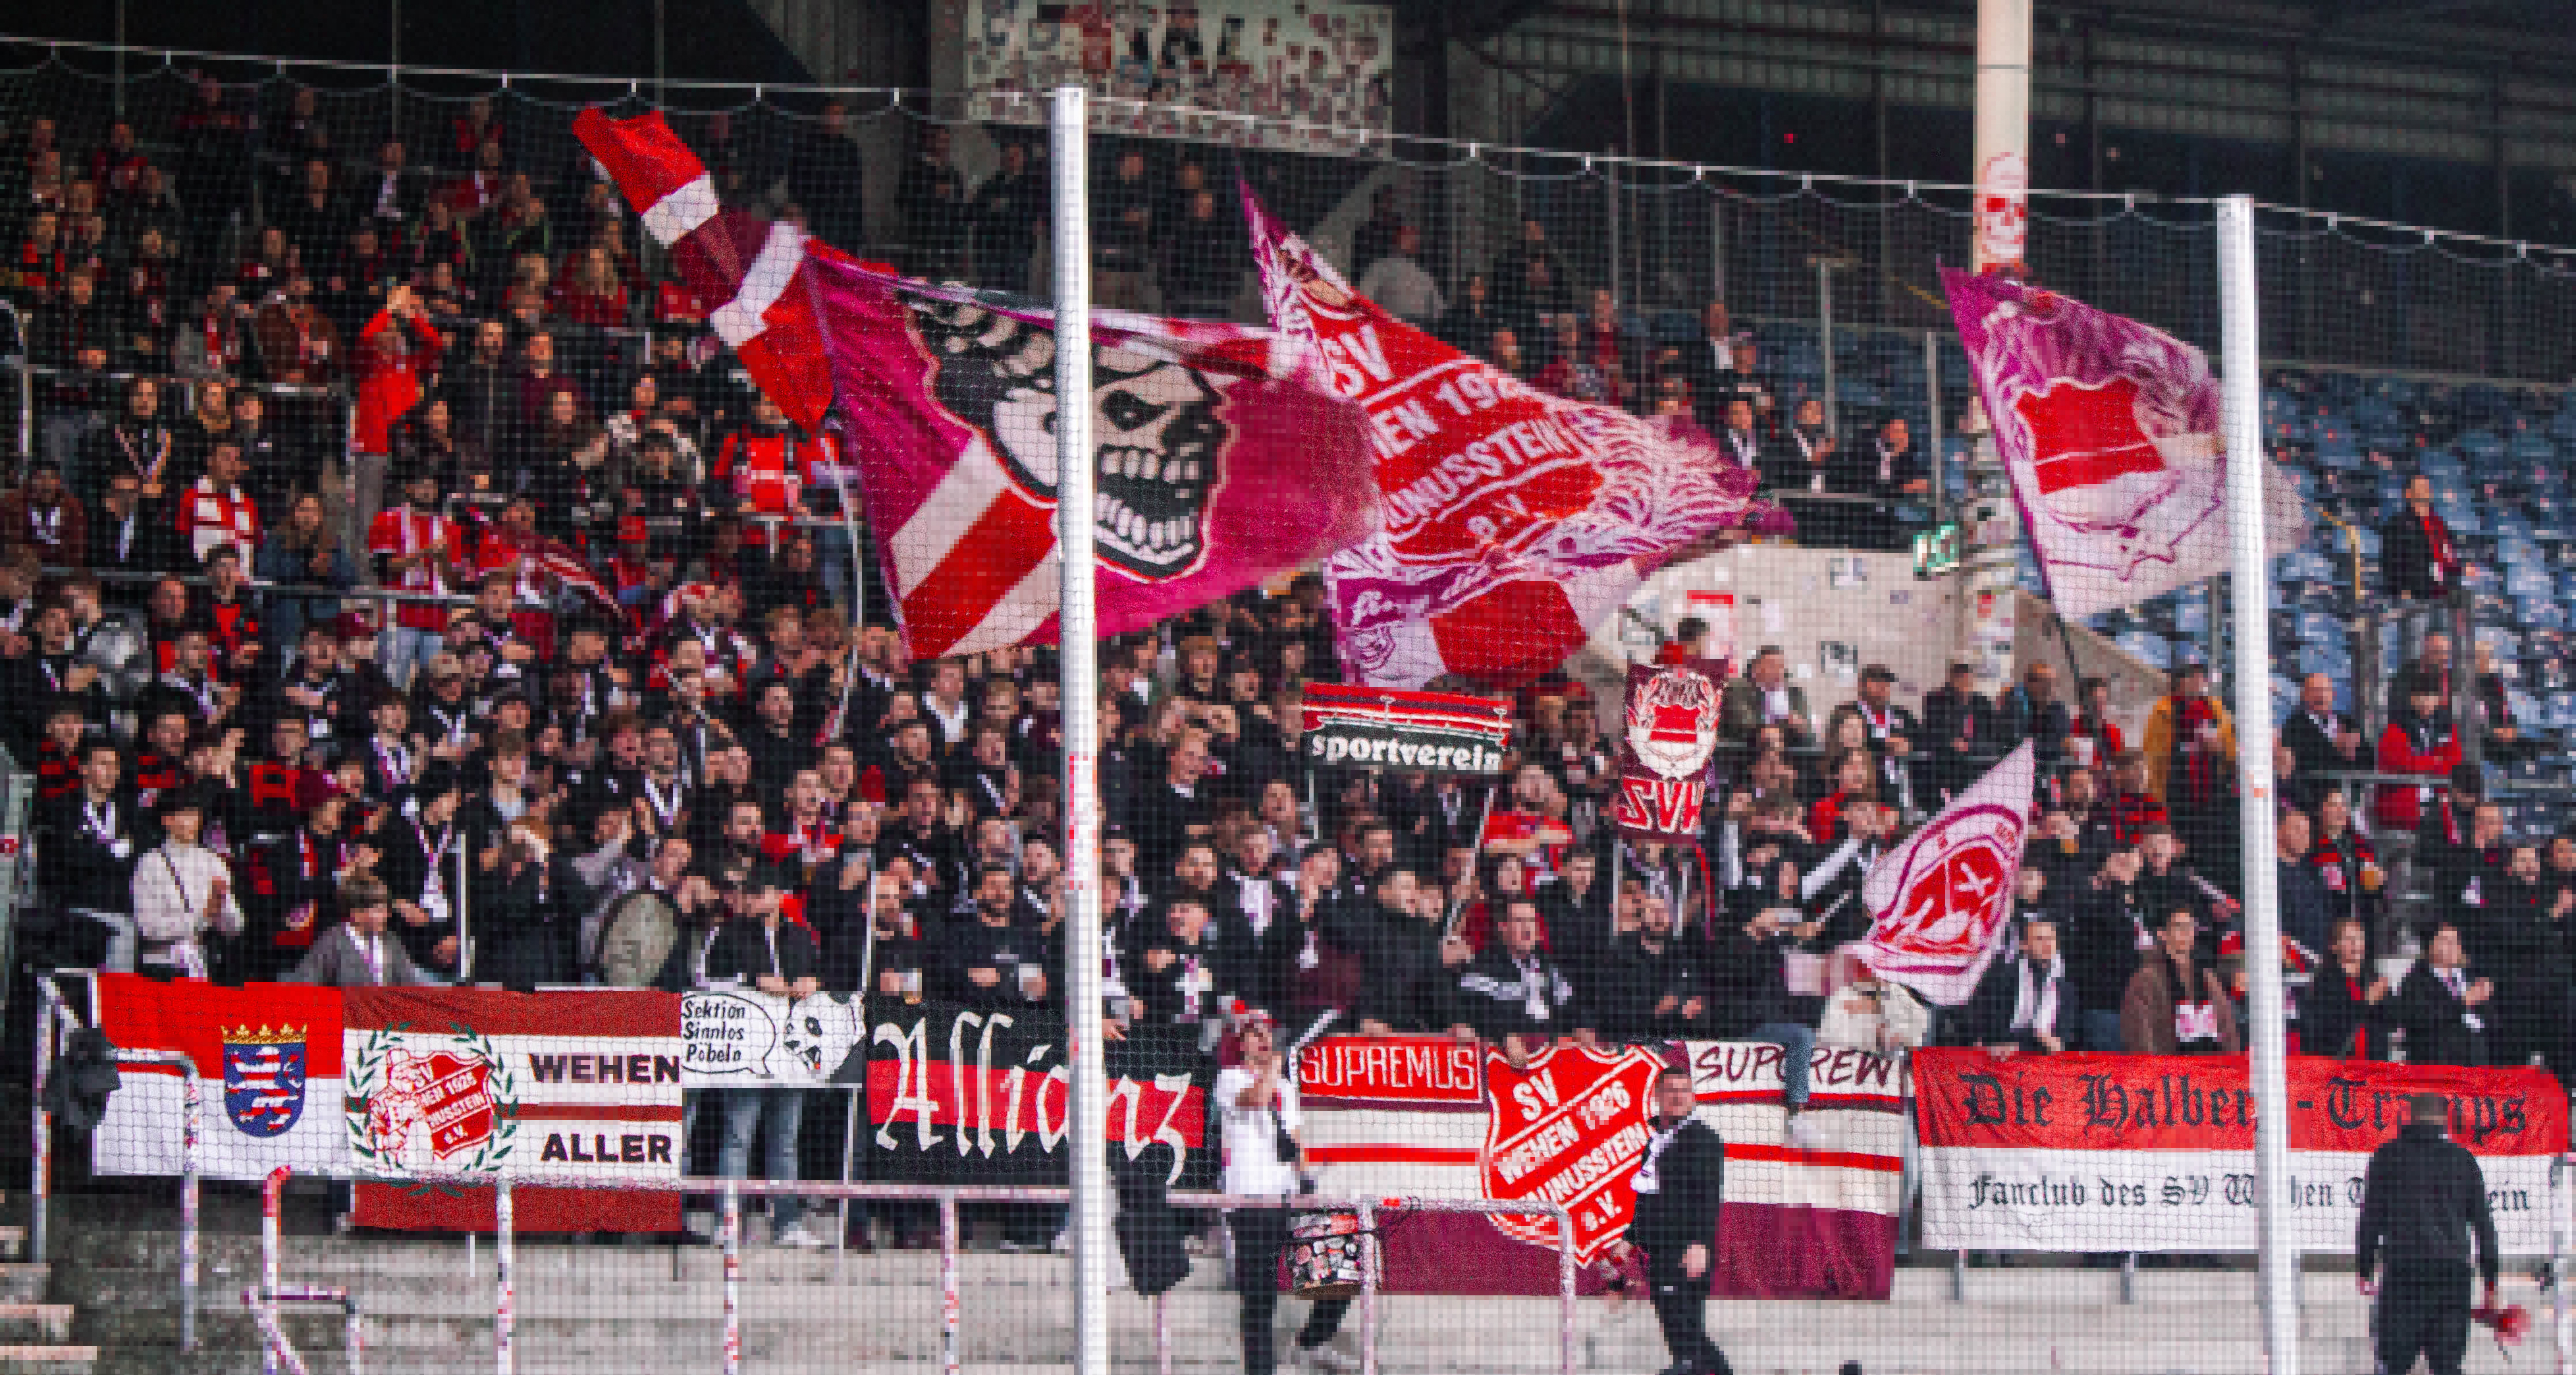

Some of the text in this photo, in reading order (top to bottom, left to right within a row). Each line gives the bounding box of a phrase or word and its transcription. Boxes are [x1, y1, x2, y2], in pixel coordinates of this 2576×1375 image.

[1312, 734, 1502, 770] sportverein
[681, 1000, 745, 1019] Sektion
[683, 1021, 744, 1040] Sinnlos
[528, 1053, 681, 1084] WEHEN
[1300, 1046, 1474, 1091] SUPREMUS
[1513, 1066, 1561, 1121] SV
[1958, 1071, 2053, 1127] Die
[540, 1132, 672, 1164] ALLER
[1496, 1115, 1580, 1185] WEHEN
[2097, 1175, 2147, 1207] des
